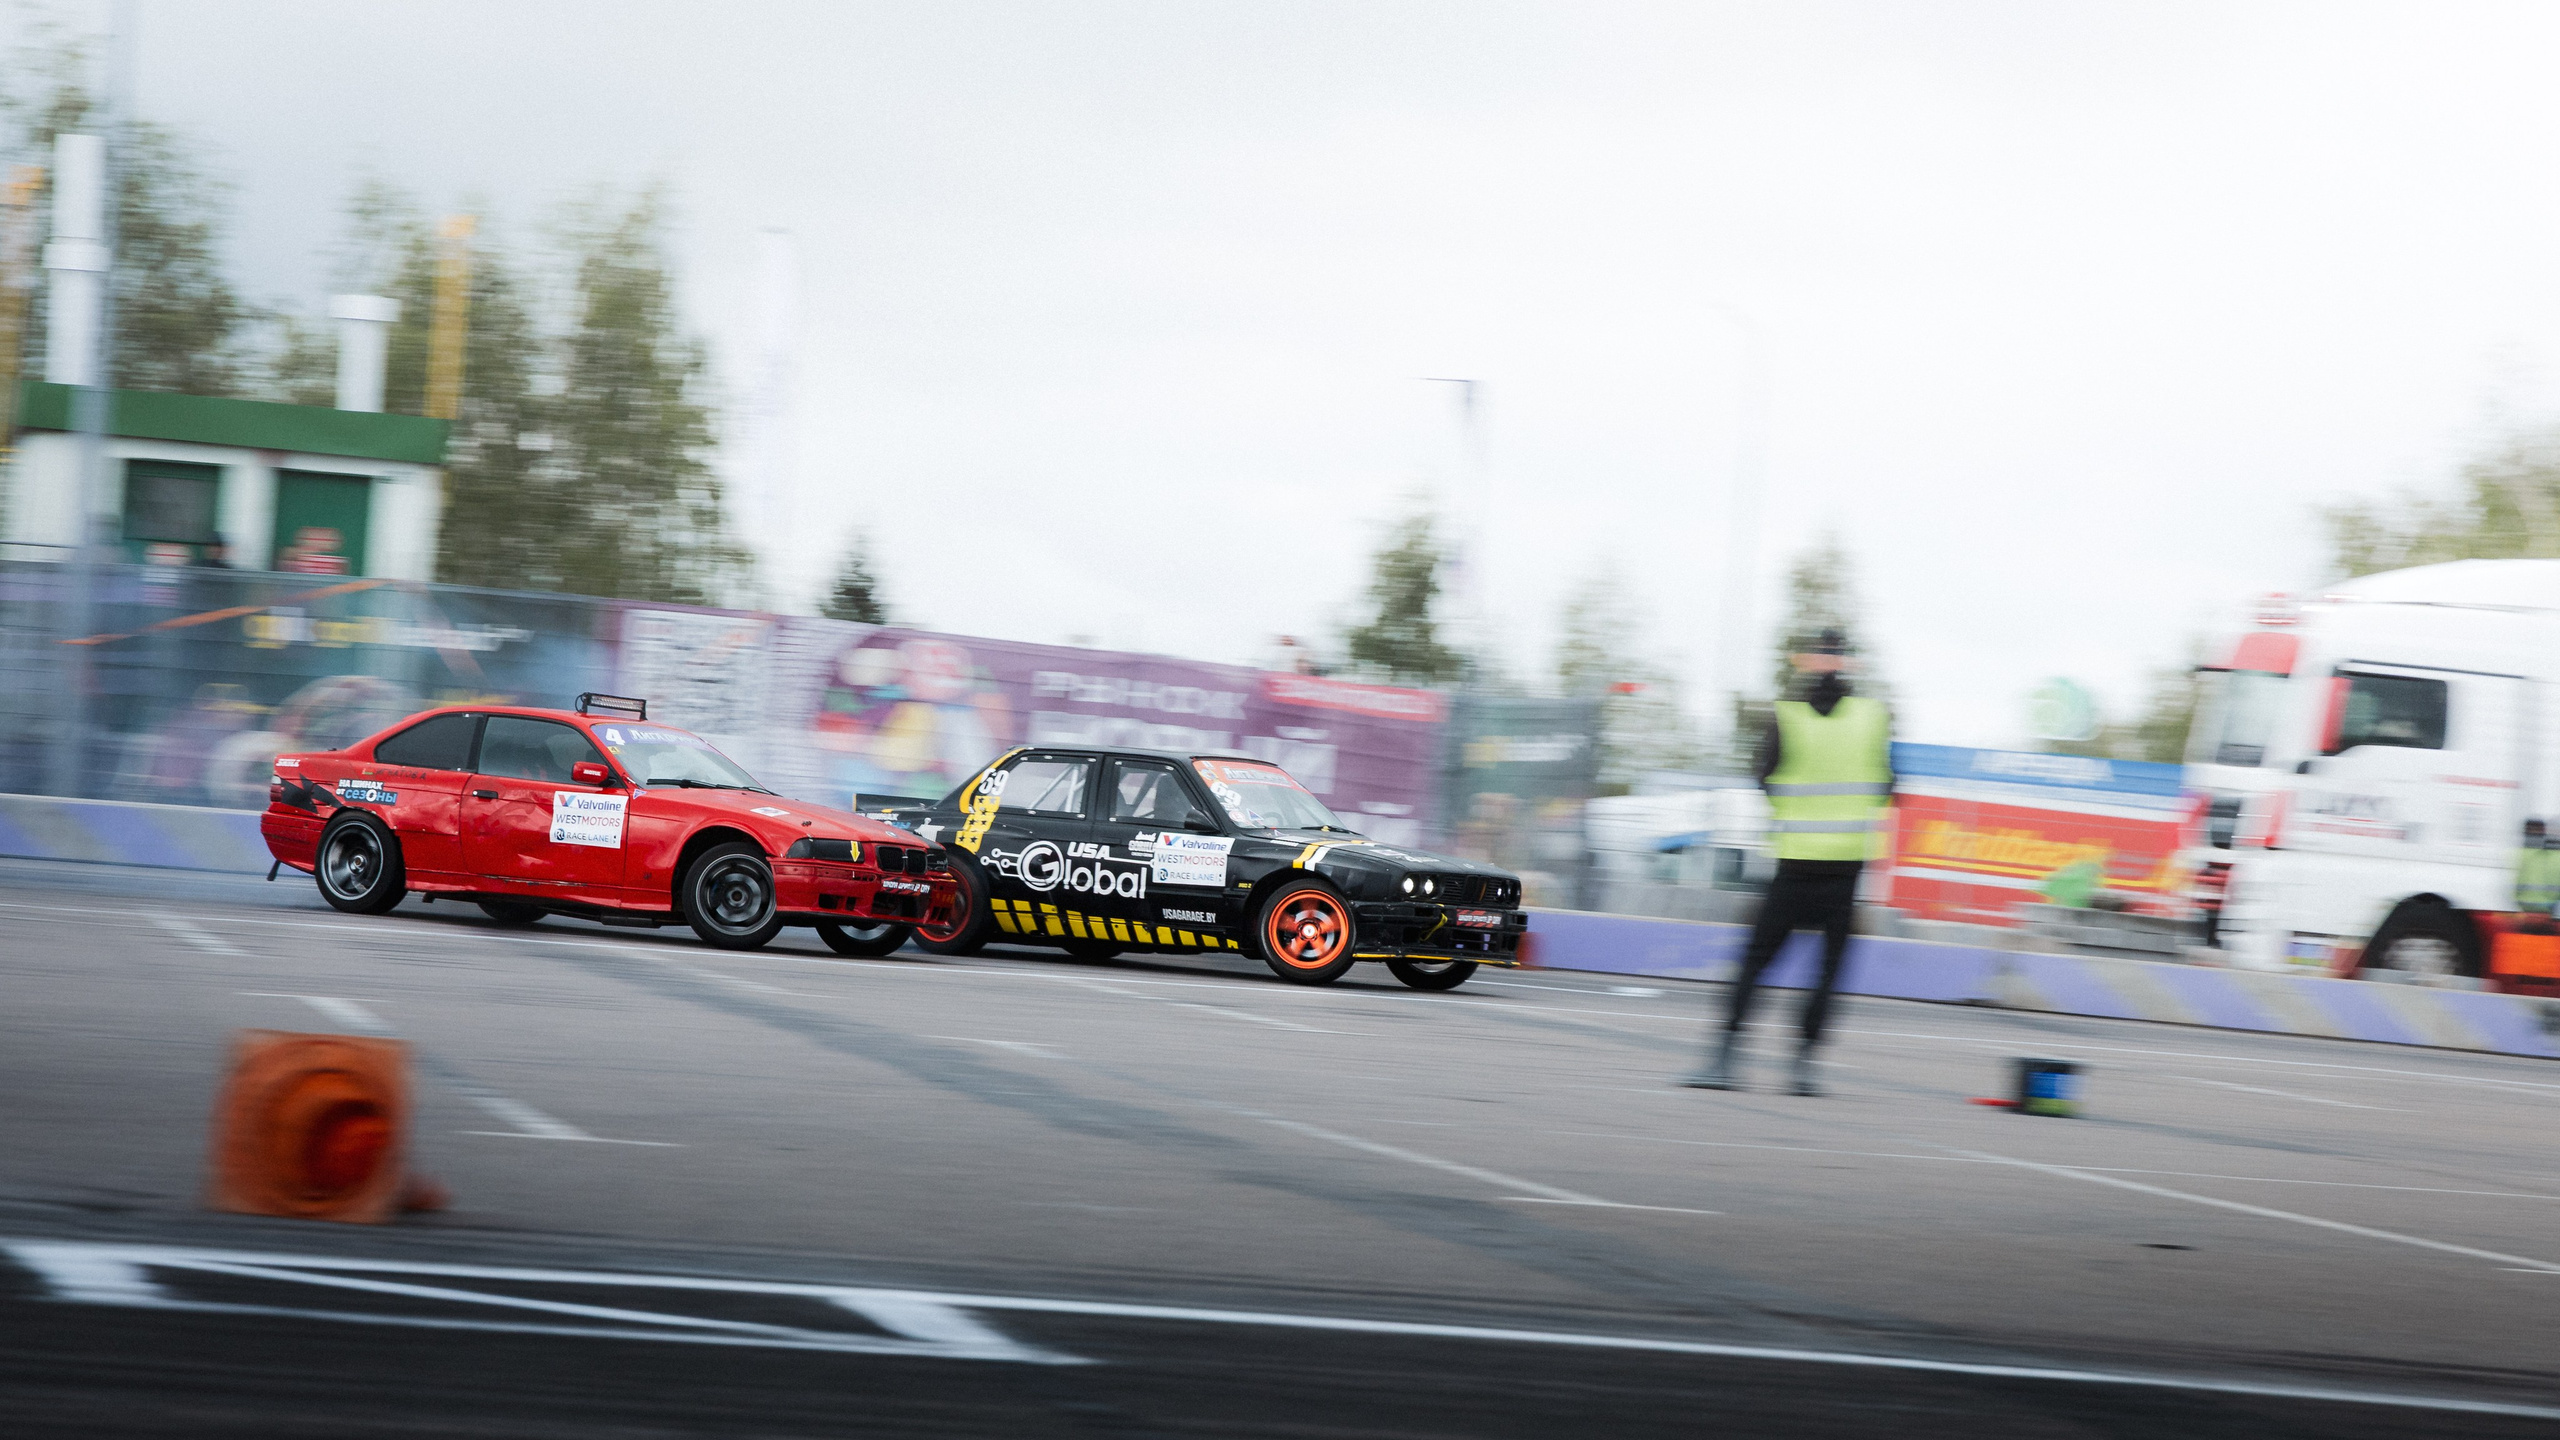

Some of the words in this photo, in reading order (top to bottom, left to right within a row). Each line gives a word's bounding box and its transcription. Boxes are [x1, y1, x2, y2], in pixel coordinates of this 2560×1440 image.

[605, 728, 625, 745] 4
[339, 779, 351, 788] НА
[352, 780, 384, 790] ШИНАХ
[979, 768, 1009, 796] 69
[1210, 781, 1242, 807] 69
[577, 799, 622, 811] Valvoline
[566, 832, 587, 841] RACE
[587, 833, 609, 843] LANE
[1067, 841, 1110, 860] USA
[1182, 840, 1227, 851] Valvoline
[1020, 844, 1148, 899] Global
[1170, 871, 1190, 880] RACE
[1192, 873, 1214, 881] LANE
[1162, 908, 1216, 923] USAGARAGE.BY
